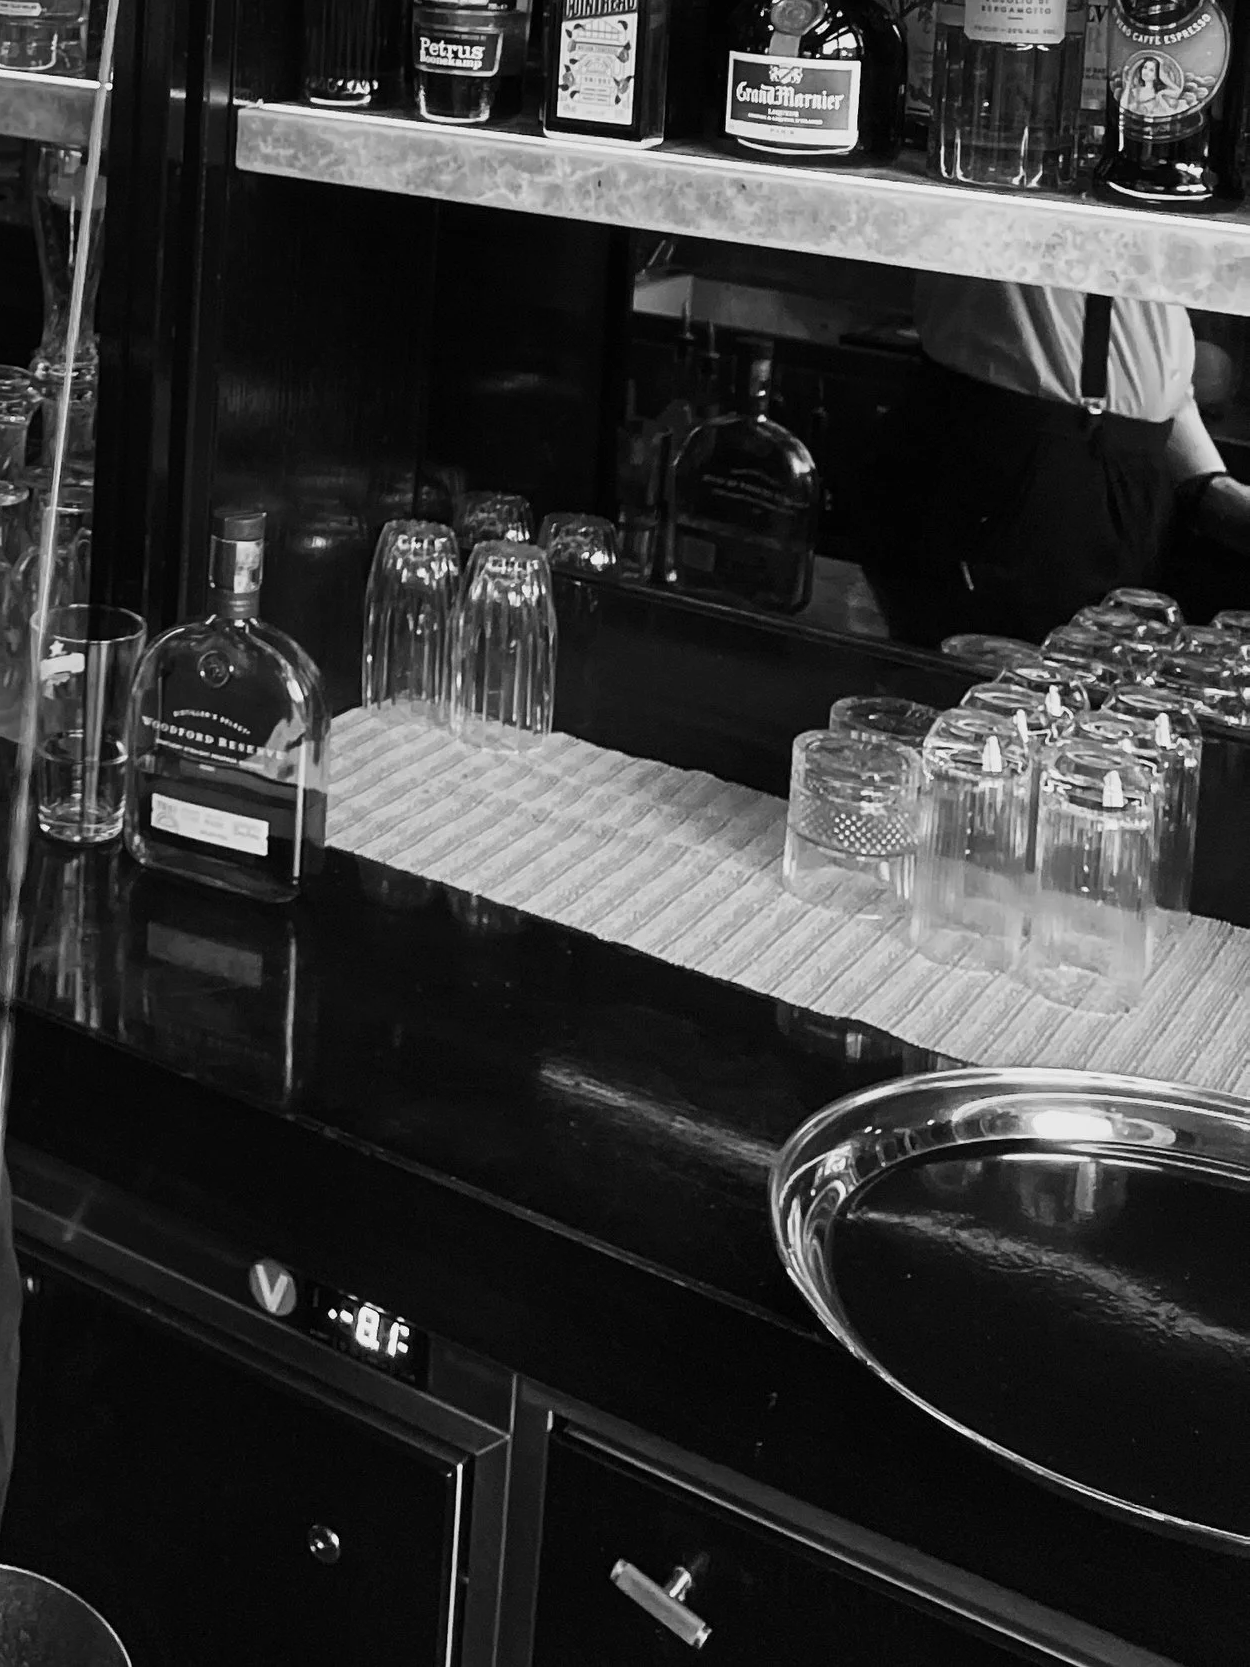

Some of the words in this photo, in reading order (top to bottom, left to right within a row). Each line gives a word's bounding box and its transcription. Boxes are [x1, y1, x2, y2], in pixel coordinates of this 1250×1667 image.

[1163, 12, 1212, 45] ESPRESSO
[419, 36, 486, 60] Petrus
[736, 80, 776, 106] Grand
[774, 84, 845, 111] Marnier
[141, 714, 215, 745] WOODFORD
[217, 736, 286, 761] RESERVE
[255, 1263, 289, 1314] V
